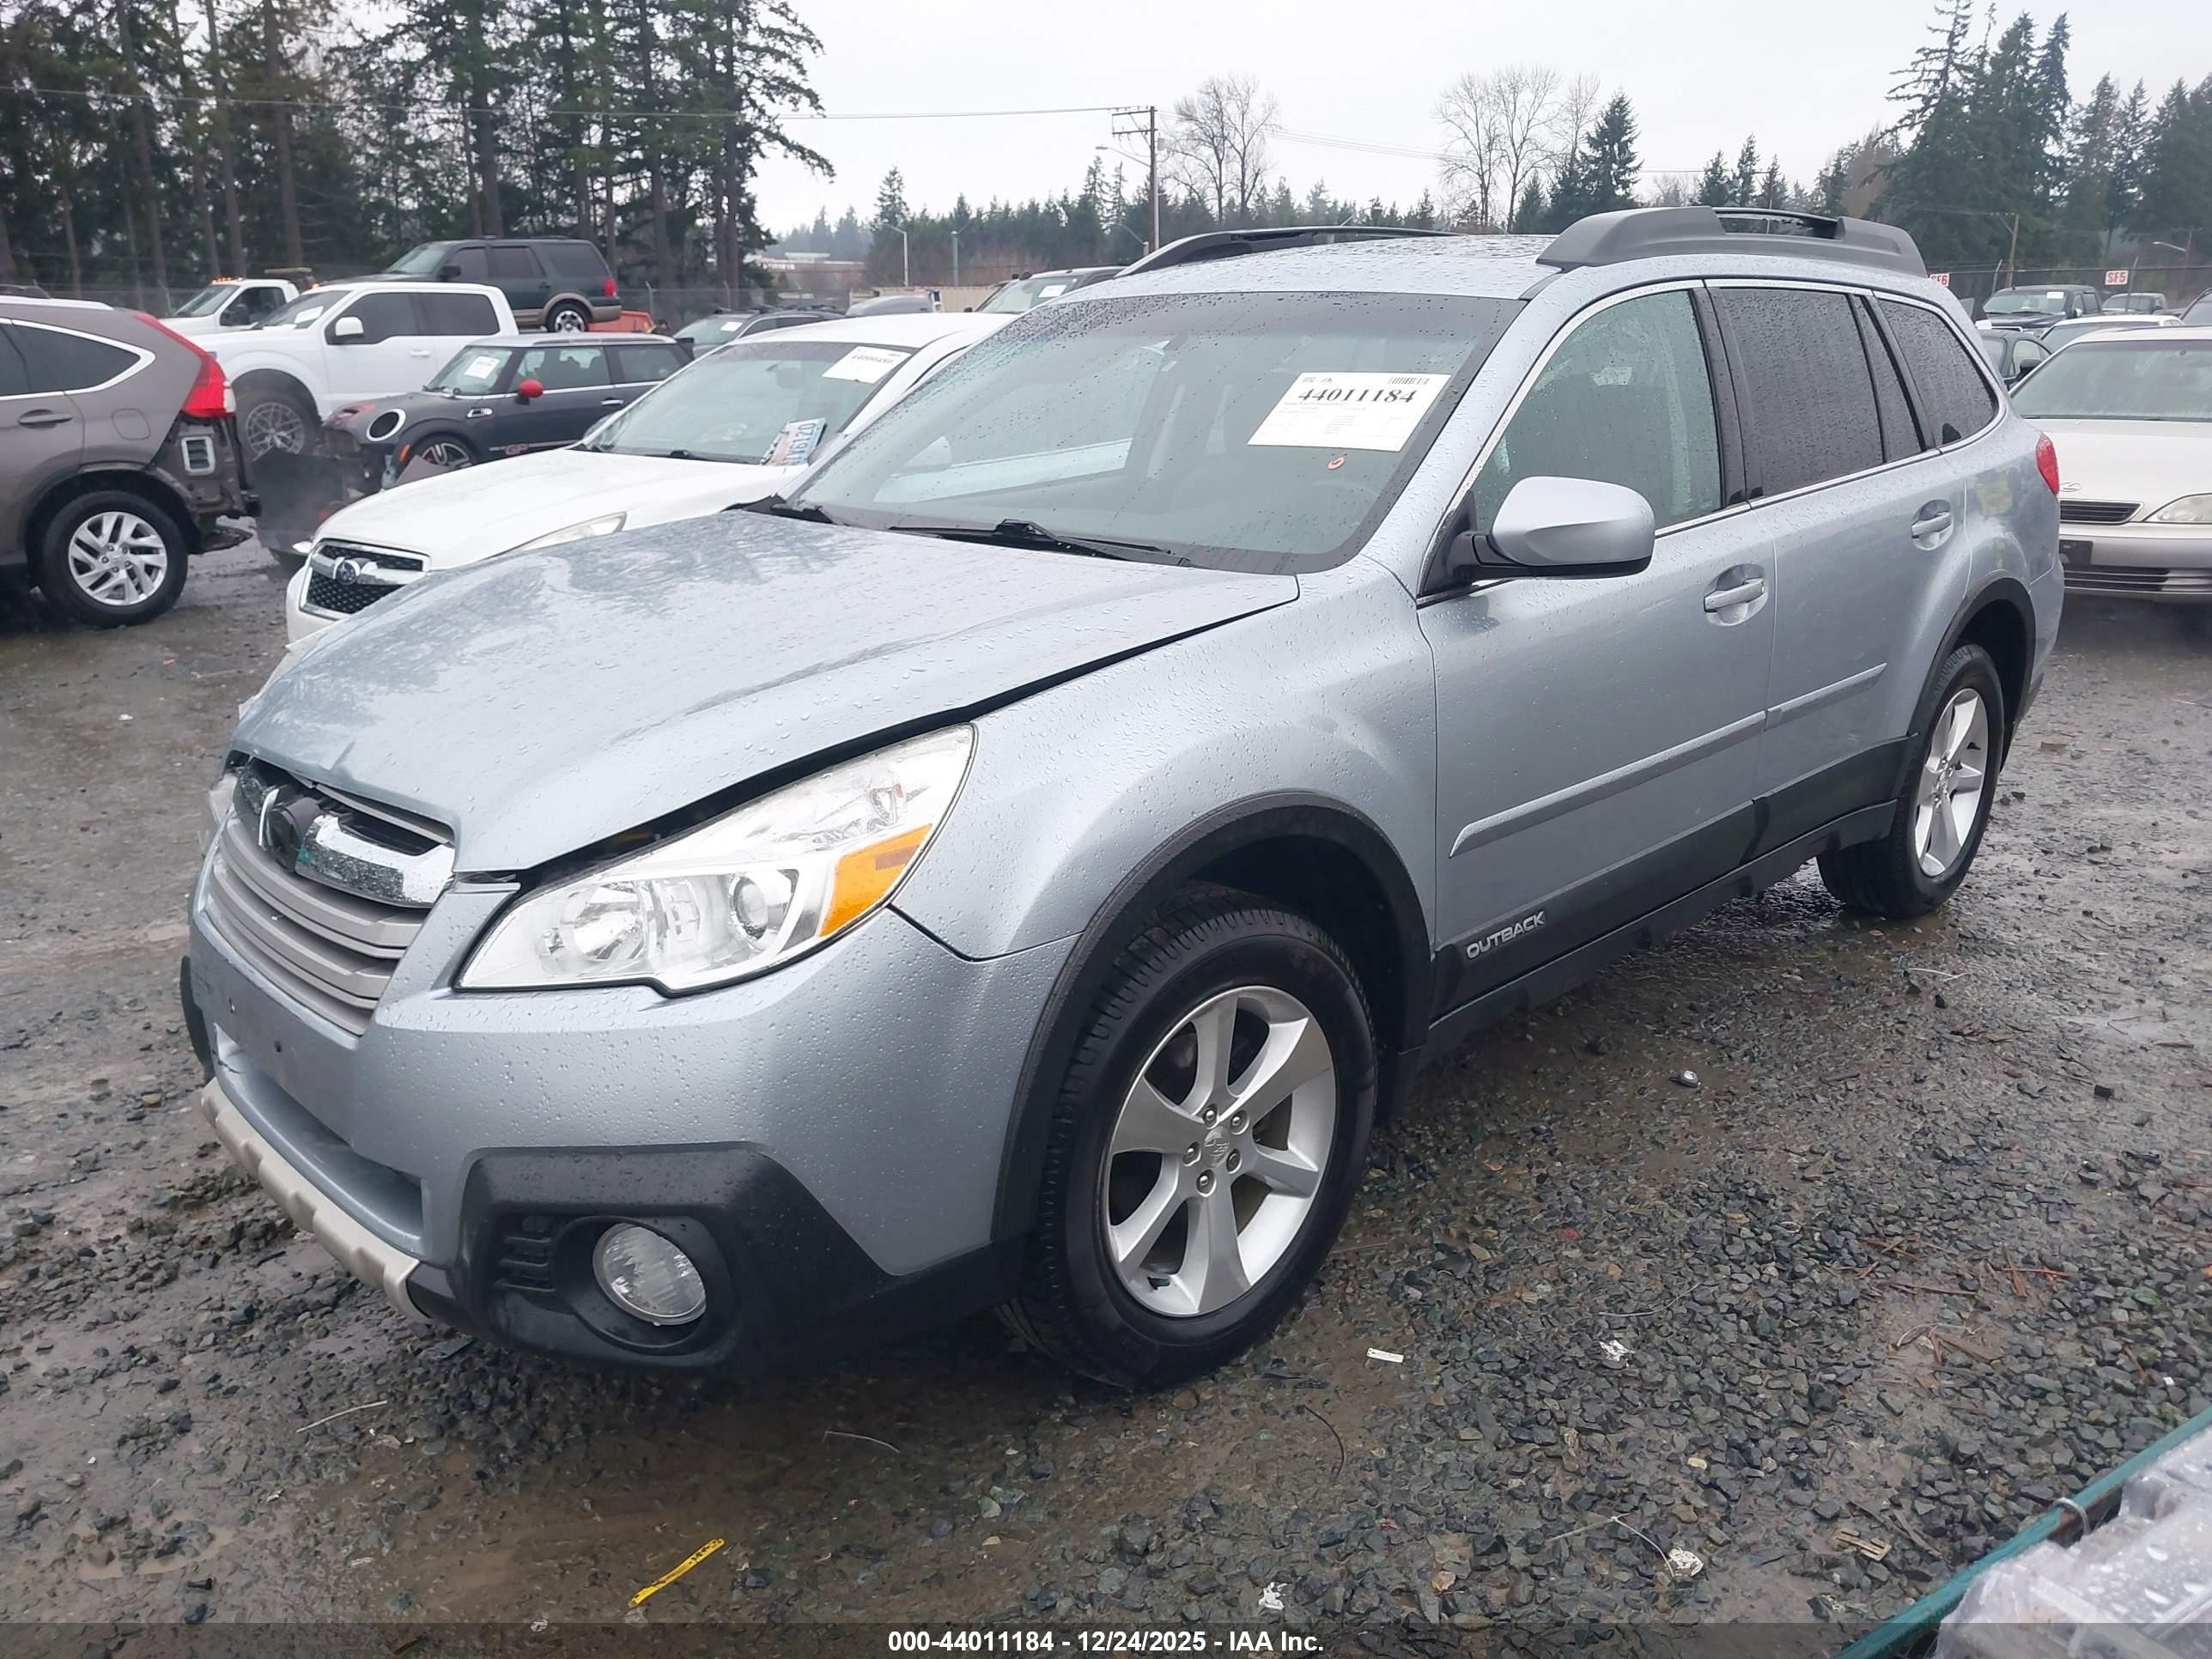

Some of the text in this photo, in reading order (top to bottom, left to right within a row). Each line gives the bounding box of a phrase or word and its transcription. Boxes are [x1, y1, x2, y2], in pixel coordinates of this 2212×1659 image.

[2107, 271, 2126, 284] SF5
[1298, 388, 1416, 403] 44011184
[1466, 910, 1546, 959] OUTBACK
